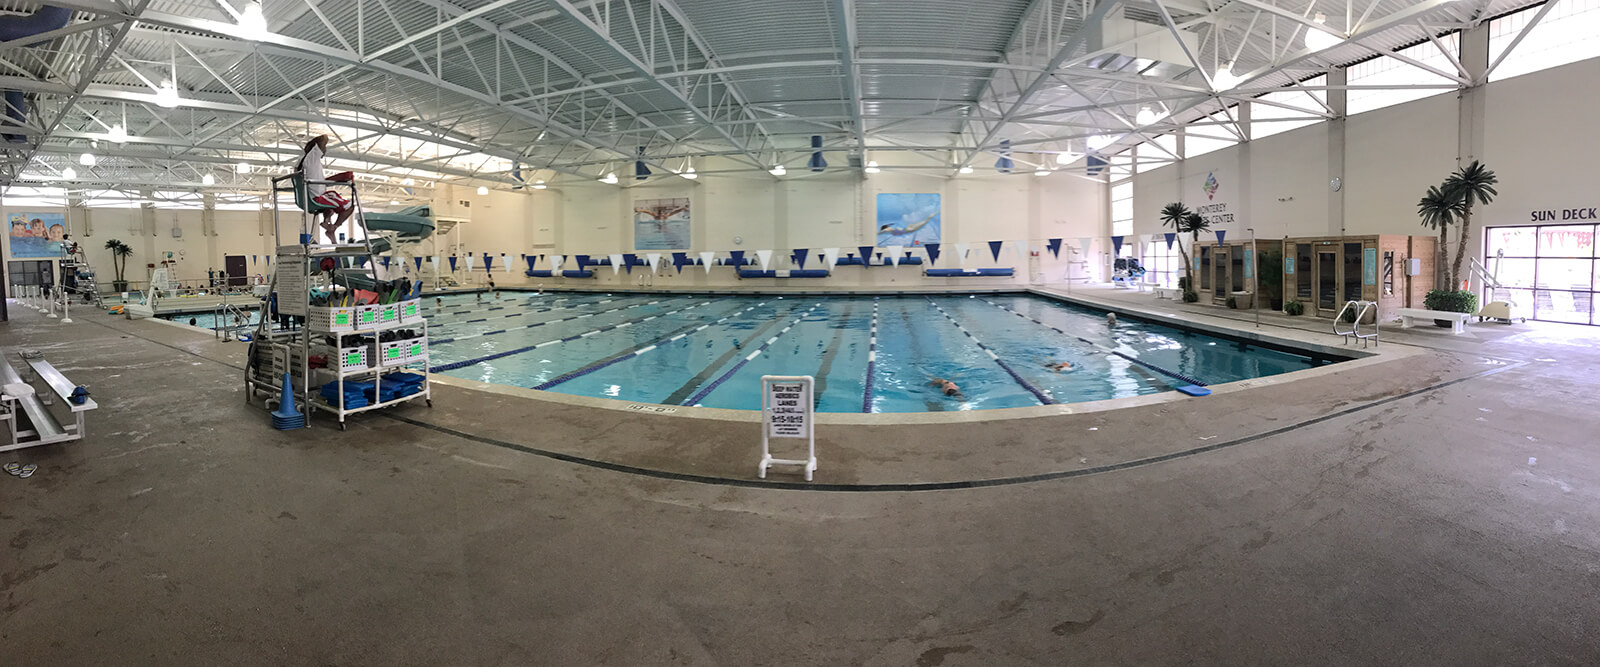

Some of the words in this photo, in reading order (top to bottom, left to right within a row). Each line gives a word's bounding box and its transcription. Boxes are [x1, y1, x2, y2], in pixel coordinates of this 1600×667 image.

[1196, 203, 1227, 214] MONTEREY
[1211, 214, 1234, 223] CENTER
[1531, 210, 1556, 221] SUN
[1562, 207, 1597, 220] DECK
[772, 384, 785, 392] DEEP
[786, 384, 803, 392] WATER
